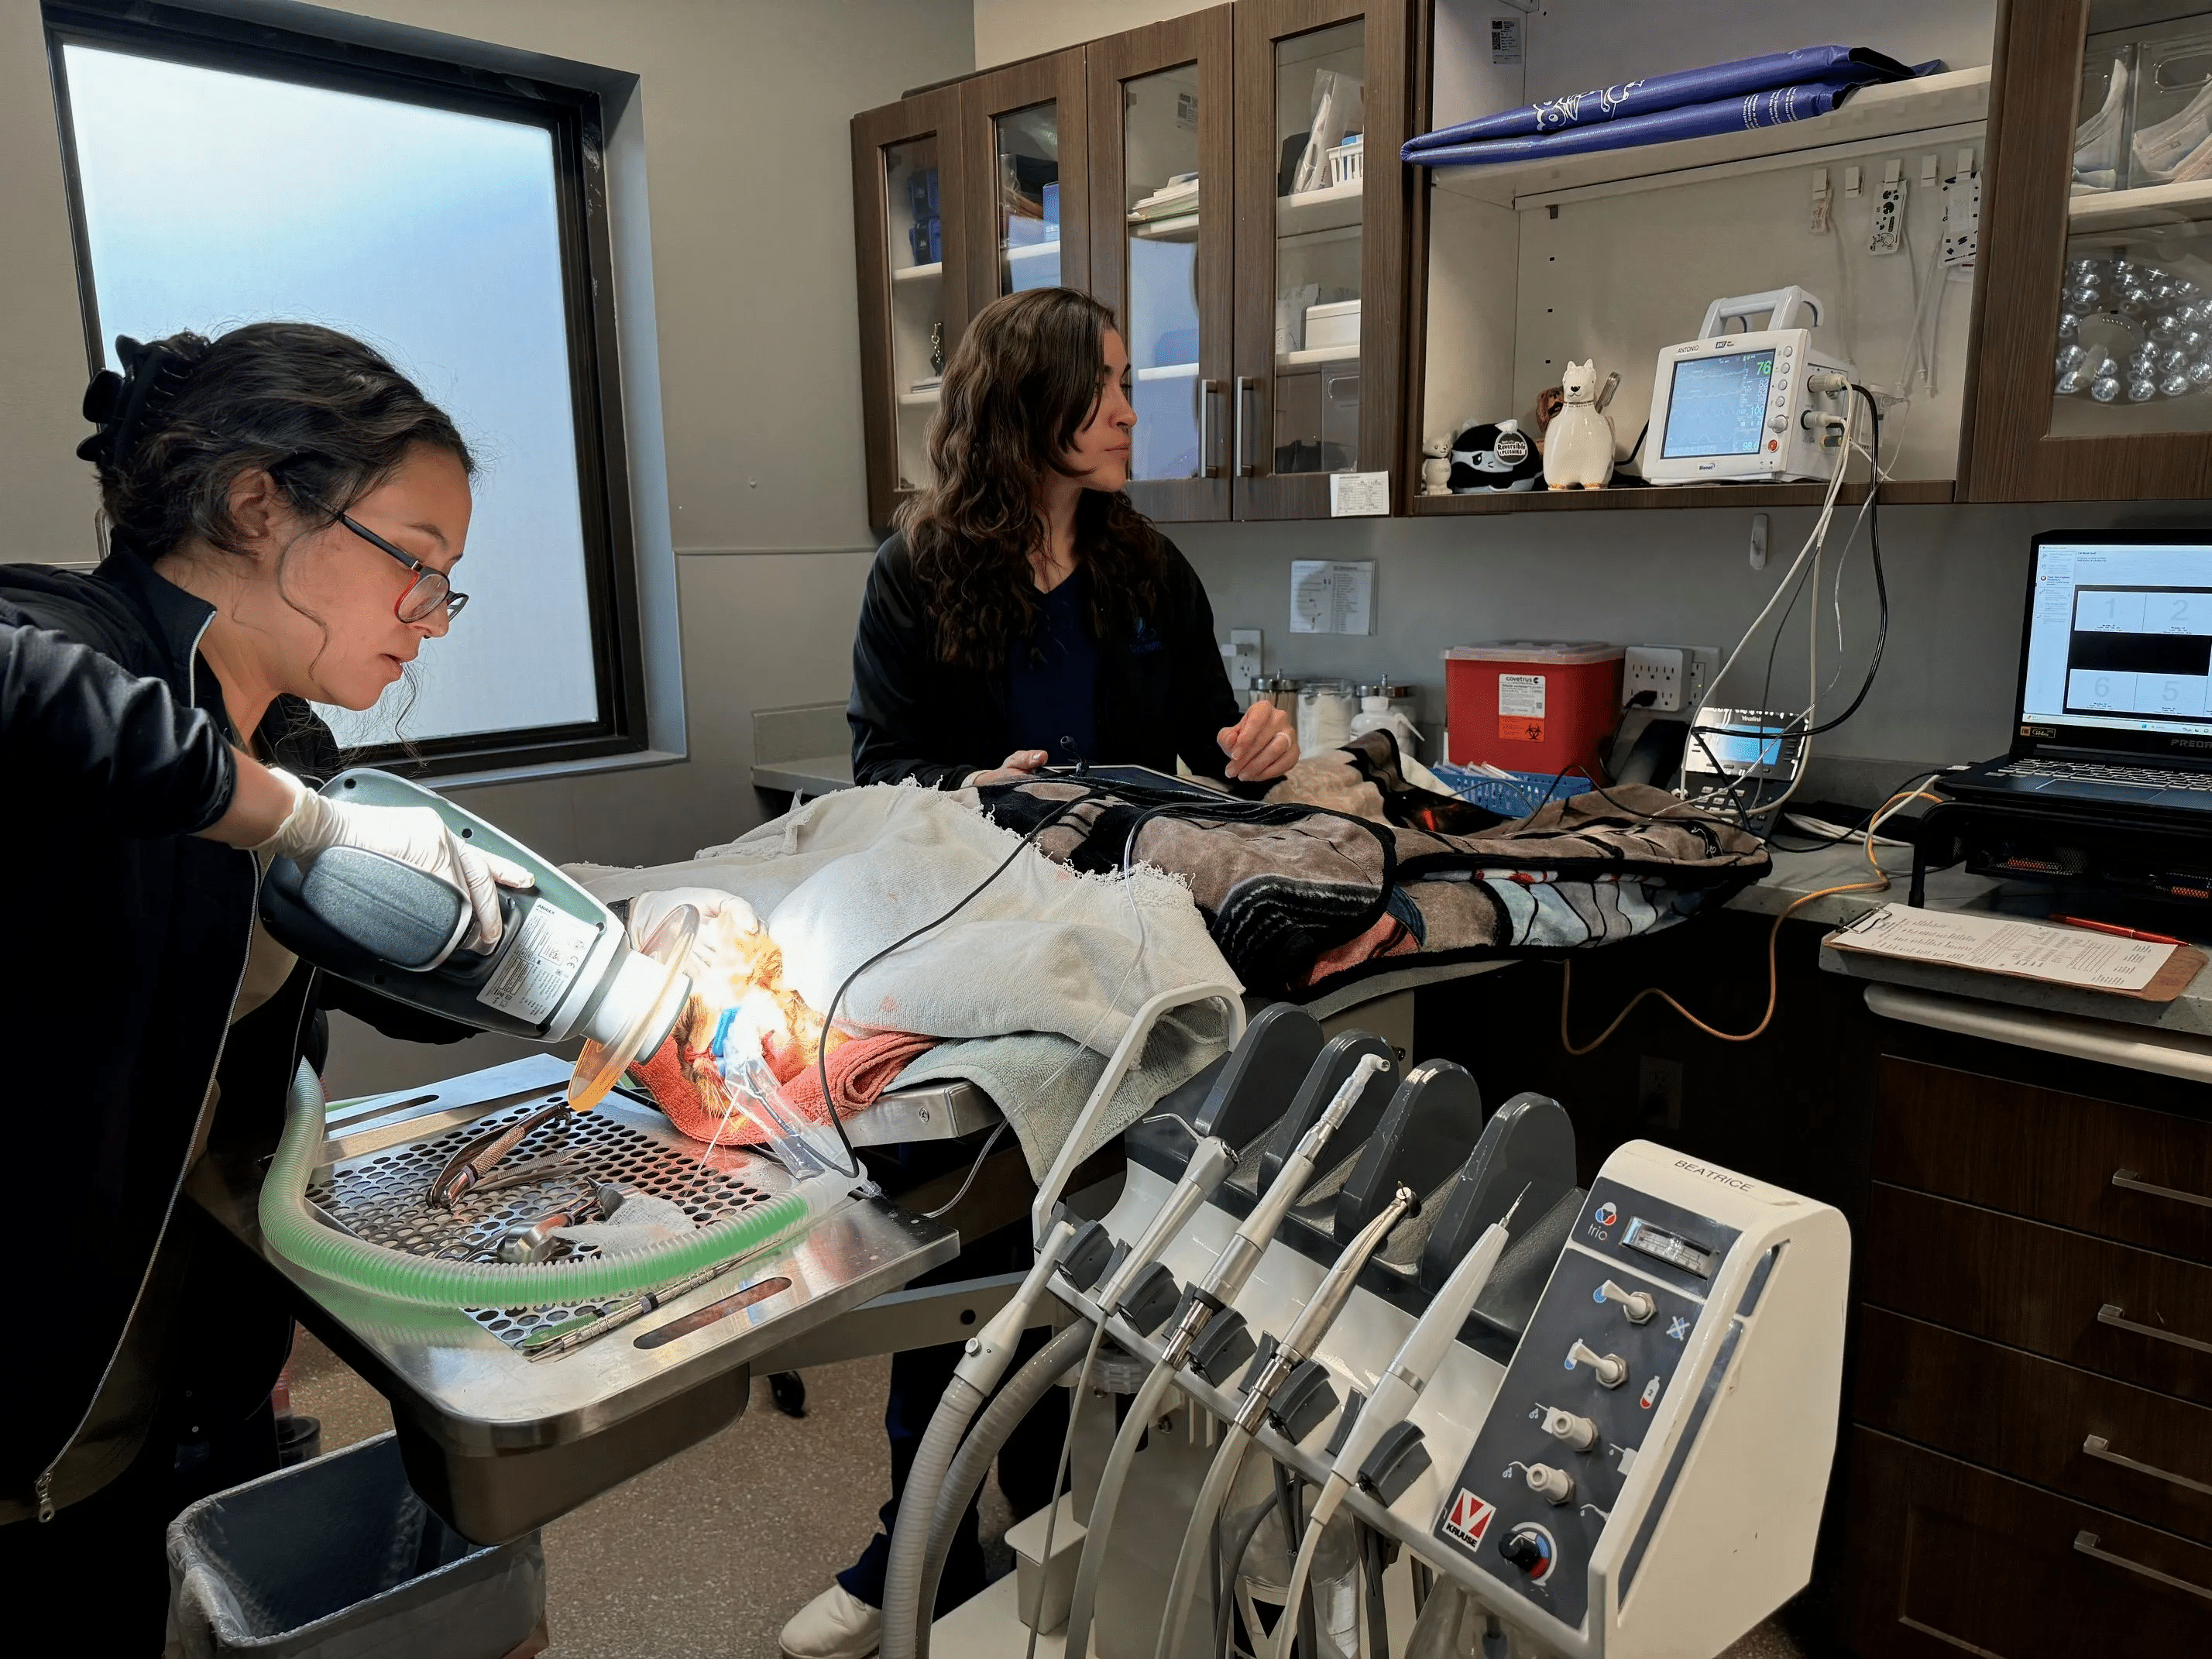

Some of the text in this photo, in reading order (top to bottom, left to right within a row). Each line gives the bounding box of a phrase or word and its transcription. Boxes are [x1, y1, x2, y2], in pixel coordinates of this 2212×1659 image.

[1757, 360, 1771, 375] 76
[1497, 442, 1526, 451] Reversible
[1743, 441, 1758, 451] 98.6
[2105, 598, 2189, 620] 1 2
[2094, 677, 2179, 701] 6 5
[1674, 1160, 1754, 1192] BEATRICE
[1588, 1224, 1607, 1240] trio
[1446, 1522, 1478, 1548] KRUUSE
